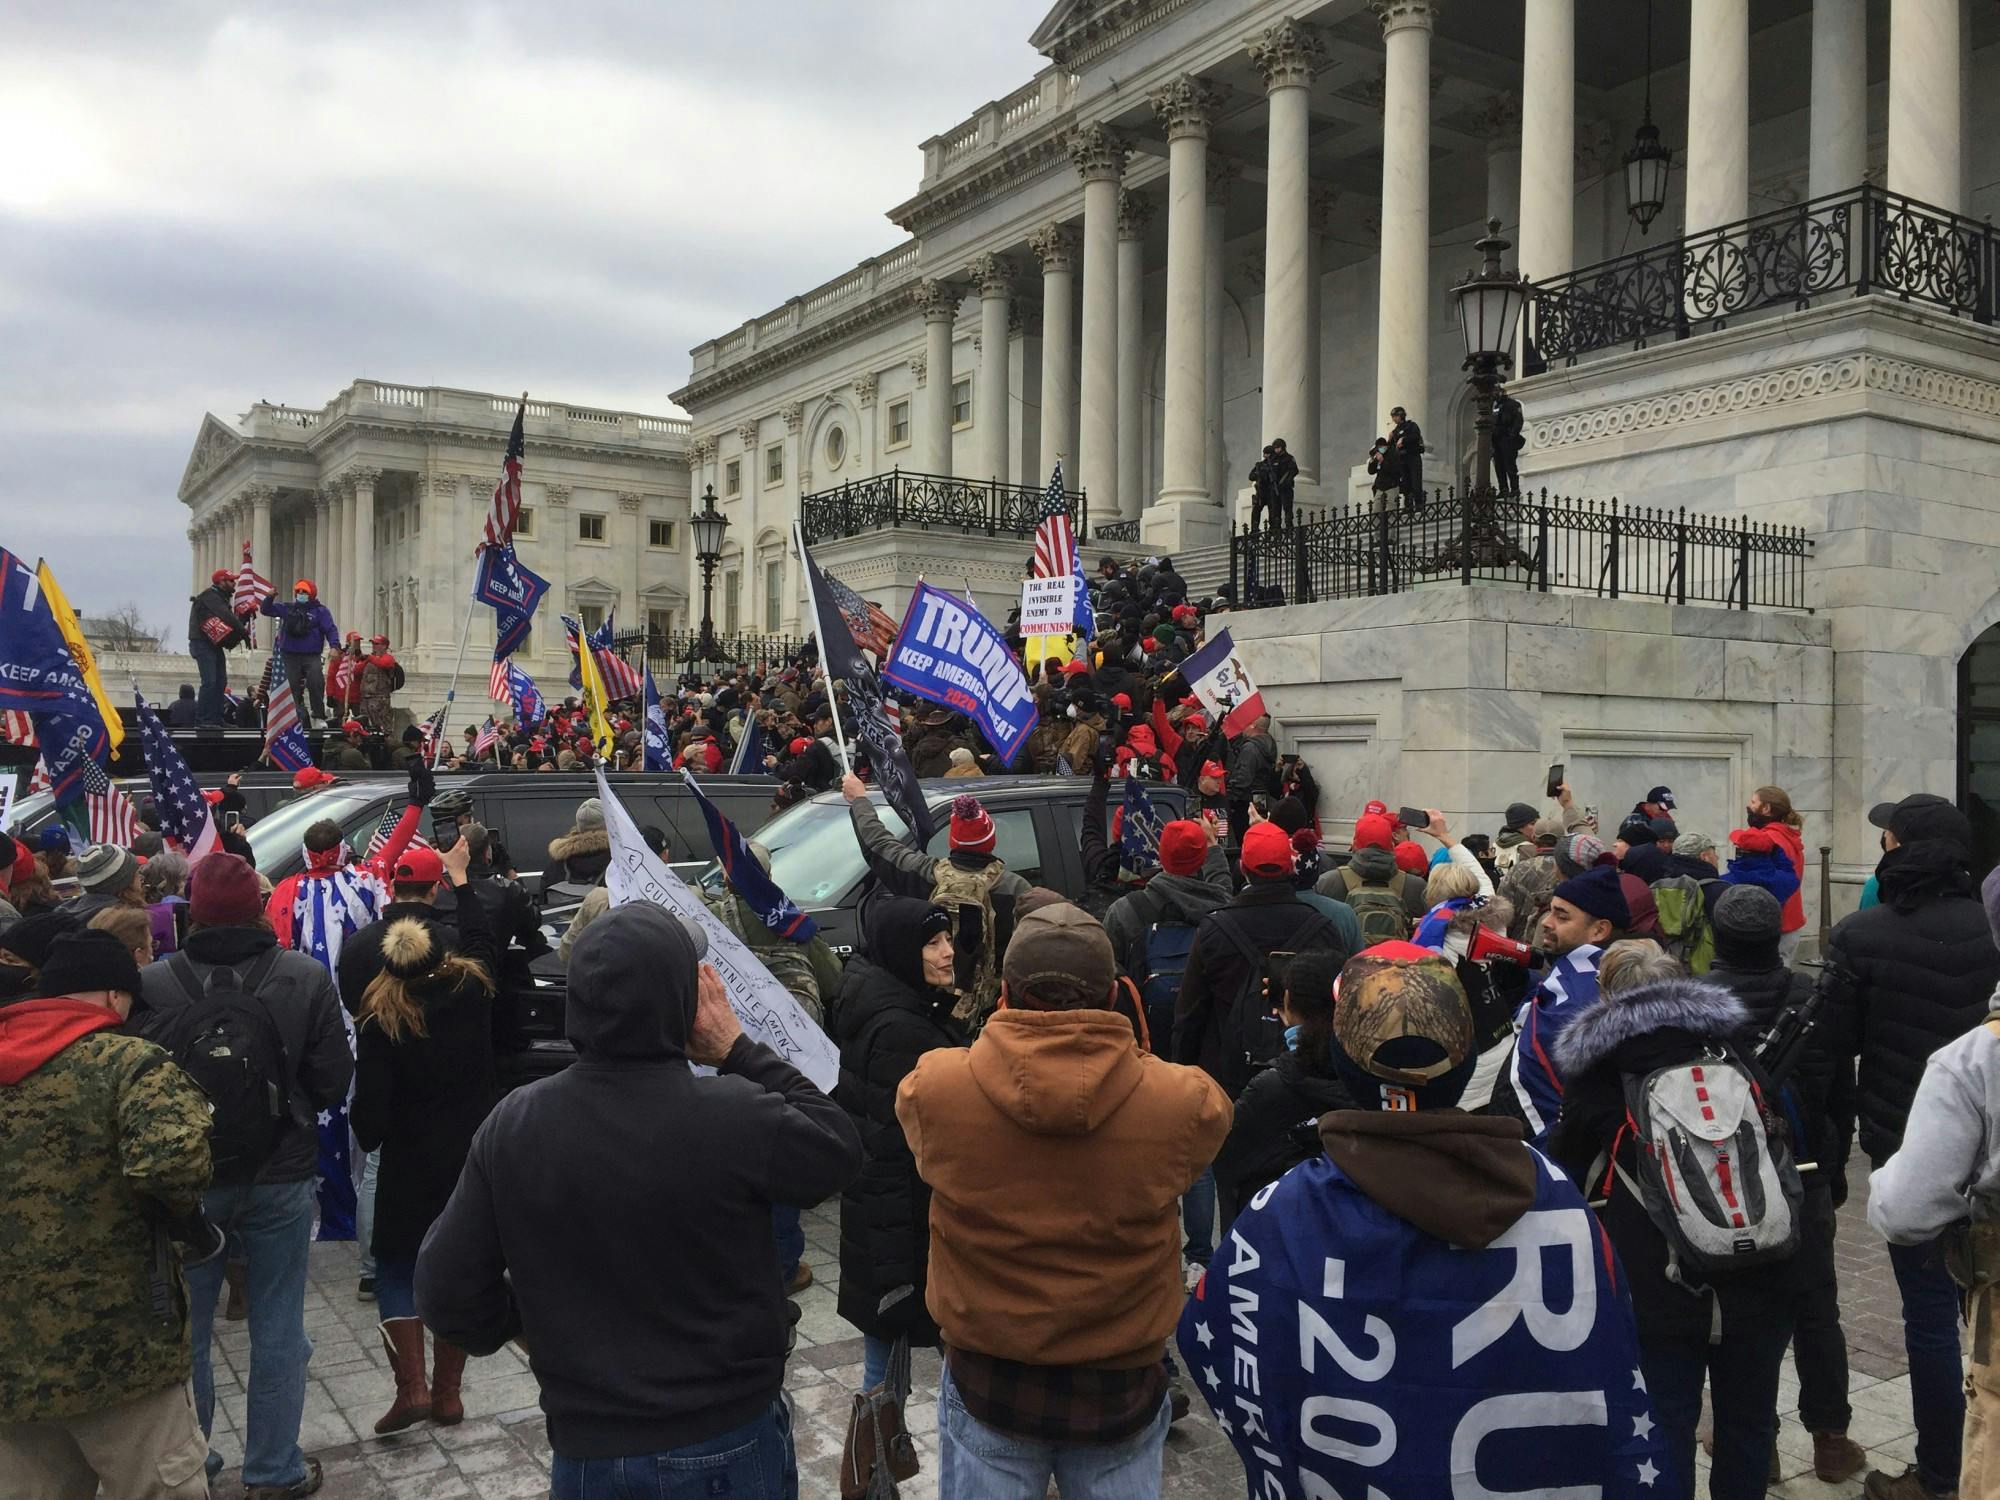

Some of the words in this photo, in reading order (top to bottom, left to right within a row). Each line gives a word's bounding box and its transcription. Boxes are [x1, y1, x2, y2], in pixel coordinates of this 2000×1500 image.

[1029, 583, 1042, 592] THE
[1047, 581, 1065, 590] REAL
[1029, 595, 1063, 605] INVISIBLE
[1026, 608, 1049, 618] ENEMY
[1054, 607, 1062, 616] IS
[1020, 622, 1073, 634] COMMUNISM
[915, 592, 1034, 713] TRUMP
[0, 664, 40, 682] KEEP
[898, 646, 934, 672] KEEP
[932, 660, 988, 705] AMERICA
[943, 688, 978, 712] 2020
[714, 957, 761, 1012] MINUTE
[769, 1019, 789, 1047] MEN
[1228, 1228, 1288, 1500] AMERIC
